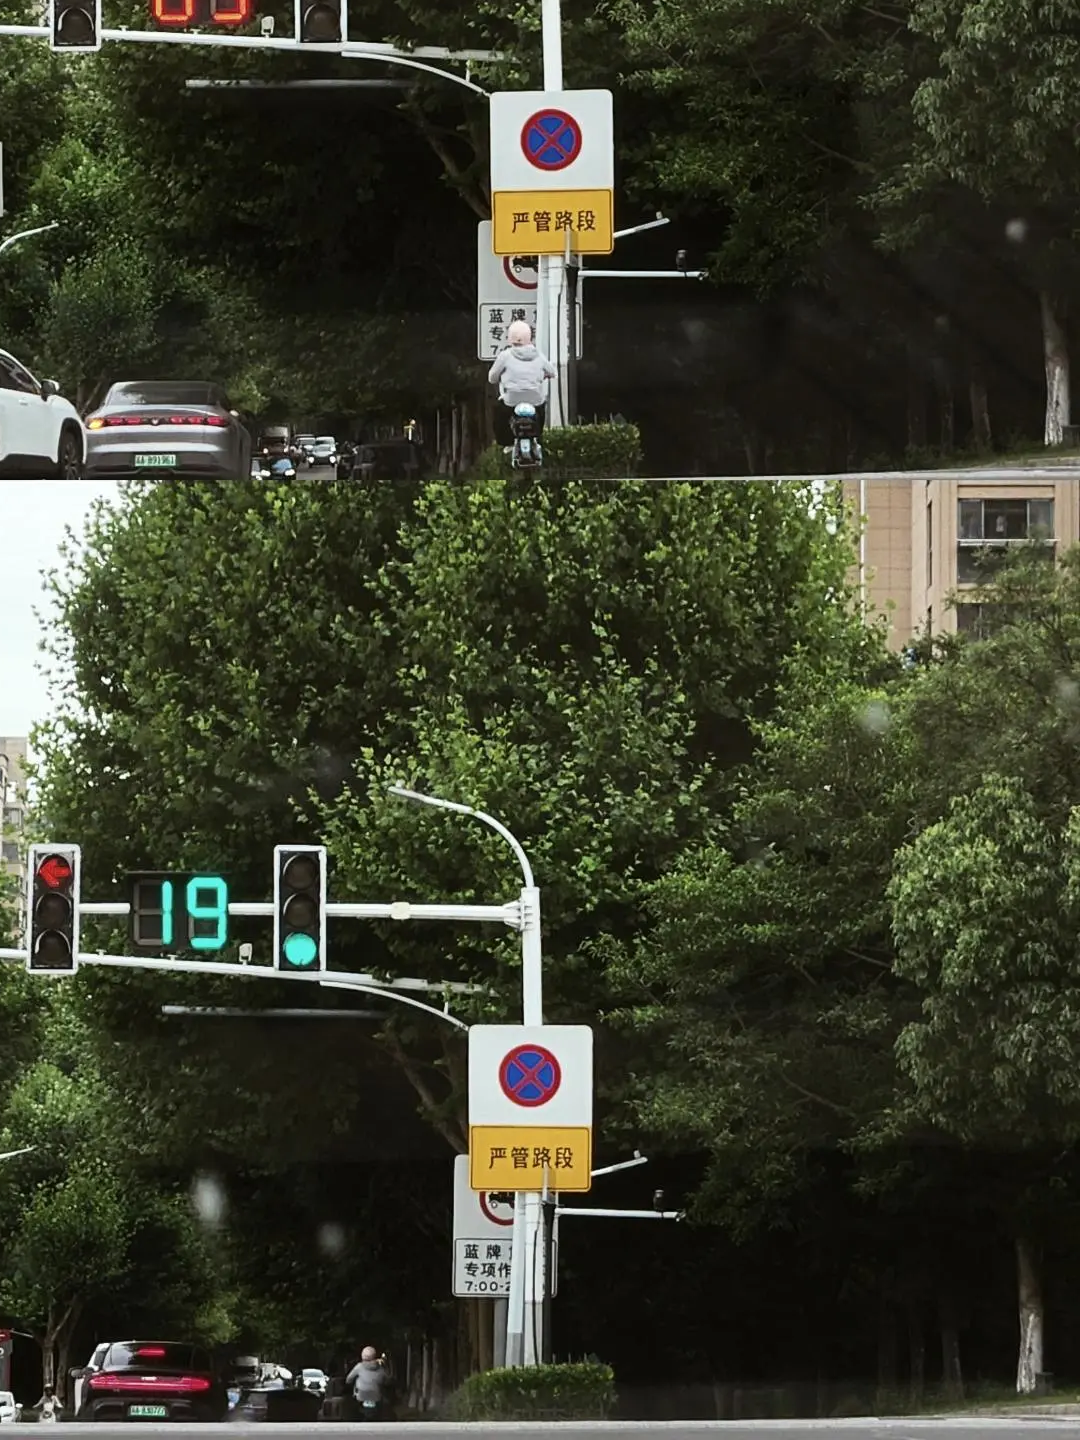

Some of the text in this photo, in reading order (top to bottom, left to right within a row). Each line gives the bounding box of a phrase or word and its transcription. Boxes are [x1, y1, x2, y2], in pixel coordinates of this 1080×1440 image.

[511, 209, 596, 233] 严管路段
[489, 308, 537, 323] 蓝牌
[161, 876, 228, 949] 19
[489, 1146, 573, 1169] 严管路段
